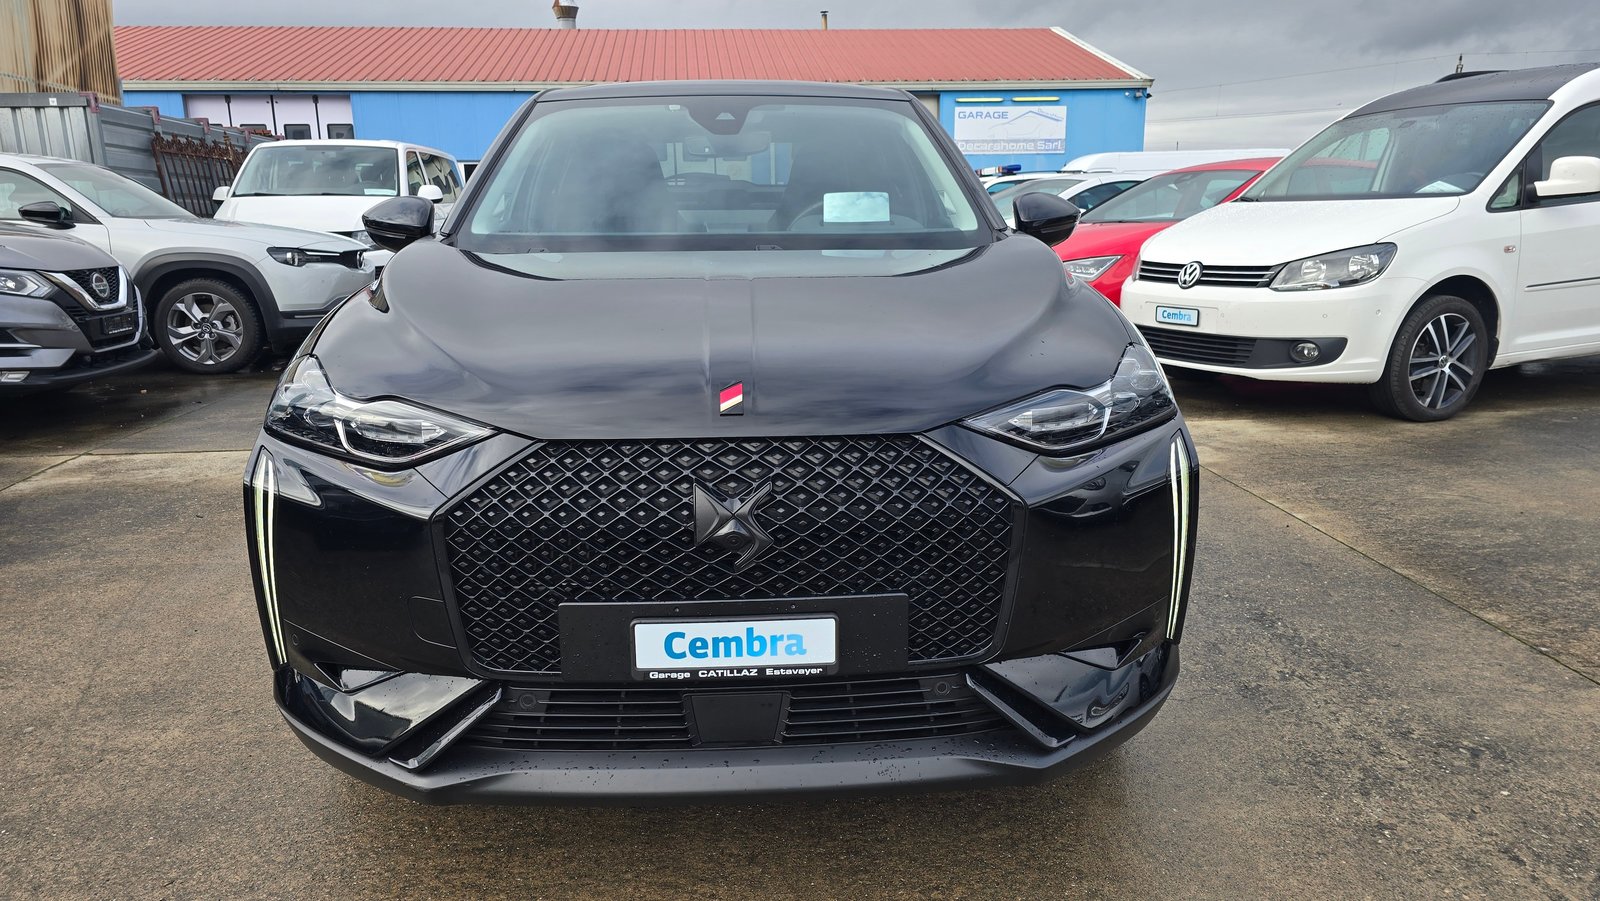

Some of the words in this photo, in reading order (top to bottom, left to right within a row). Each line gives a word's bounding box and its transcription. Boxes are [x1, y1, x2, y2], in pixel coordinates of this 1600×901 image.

[958, 111, 1008, 119] GARAGE
[1162, 310, 1191, 321] Cembra
[664, 627, 807, 659] Cembra
[649, 671, 691, 679] Garage
[698, 668, 758, 677] CATILLAZ
[765, 667, 823, 676] Estavayer
